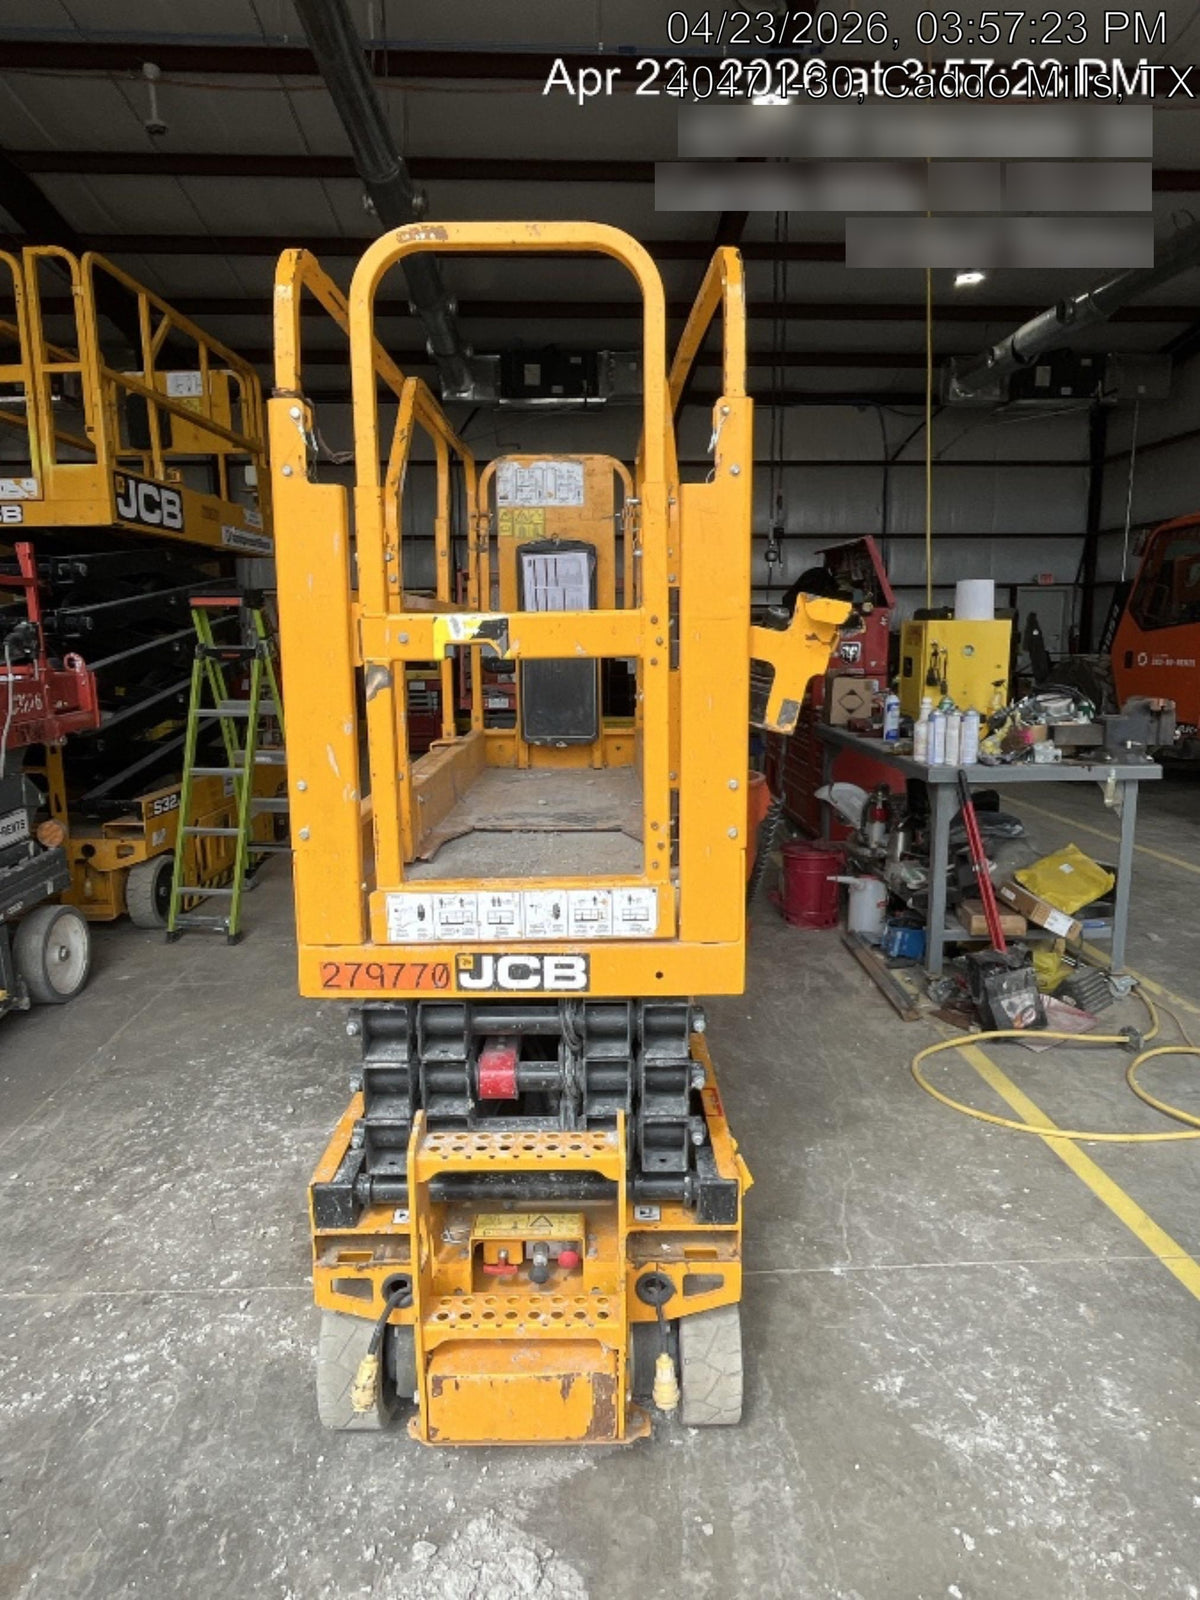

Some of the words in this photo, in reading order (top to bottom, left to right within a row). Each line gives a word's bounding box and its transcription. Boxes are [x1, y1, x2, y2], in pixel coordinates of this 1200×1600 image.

[0, 504, 23, 524] B
[116, 479, 183, 529] JCB
[322, 962, 450, 990] 279770
[458, 955, 588, 990] JCB
